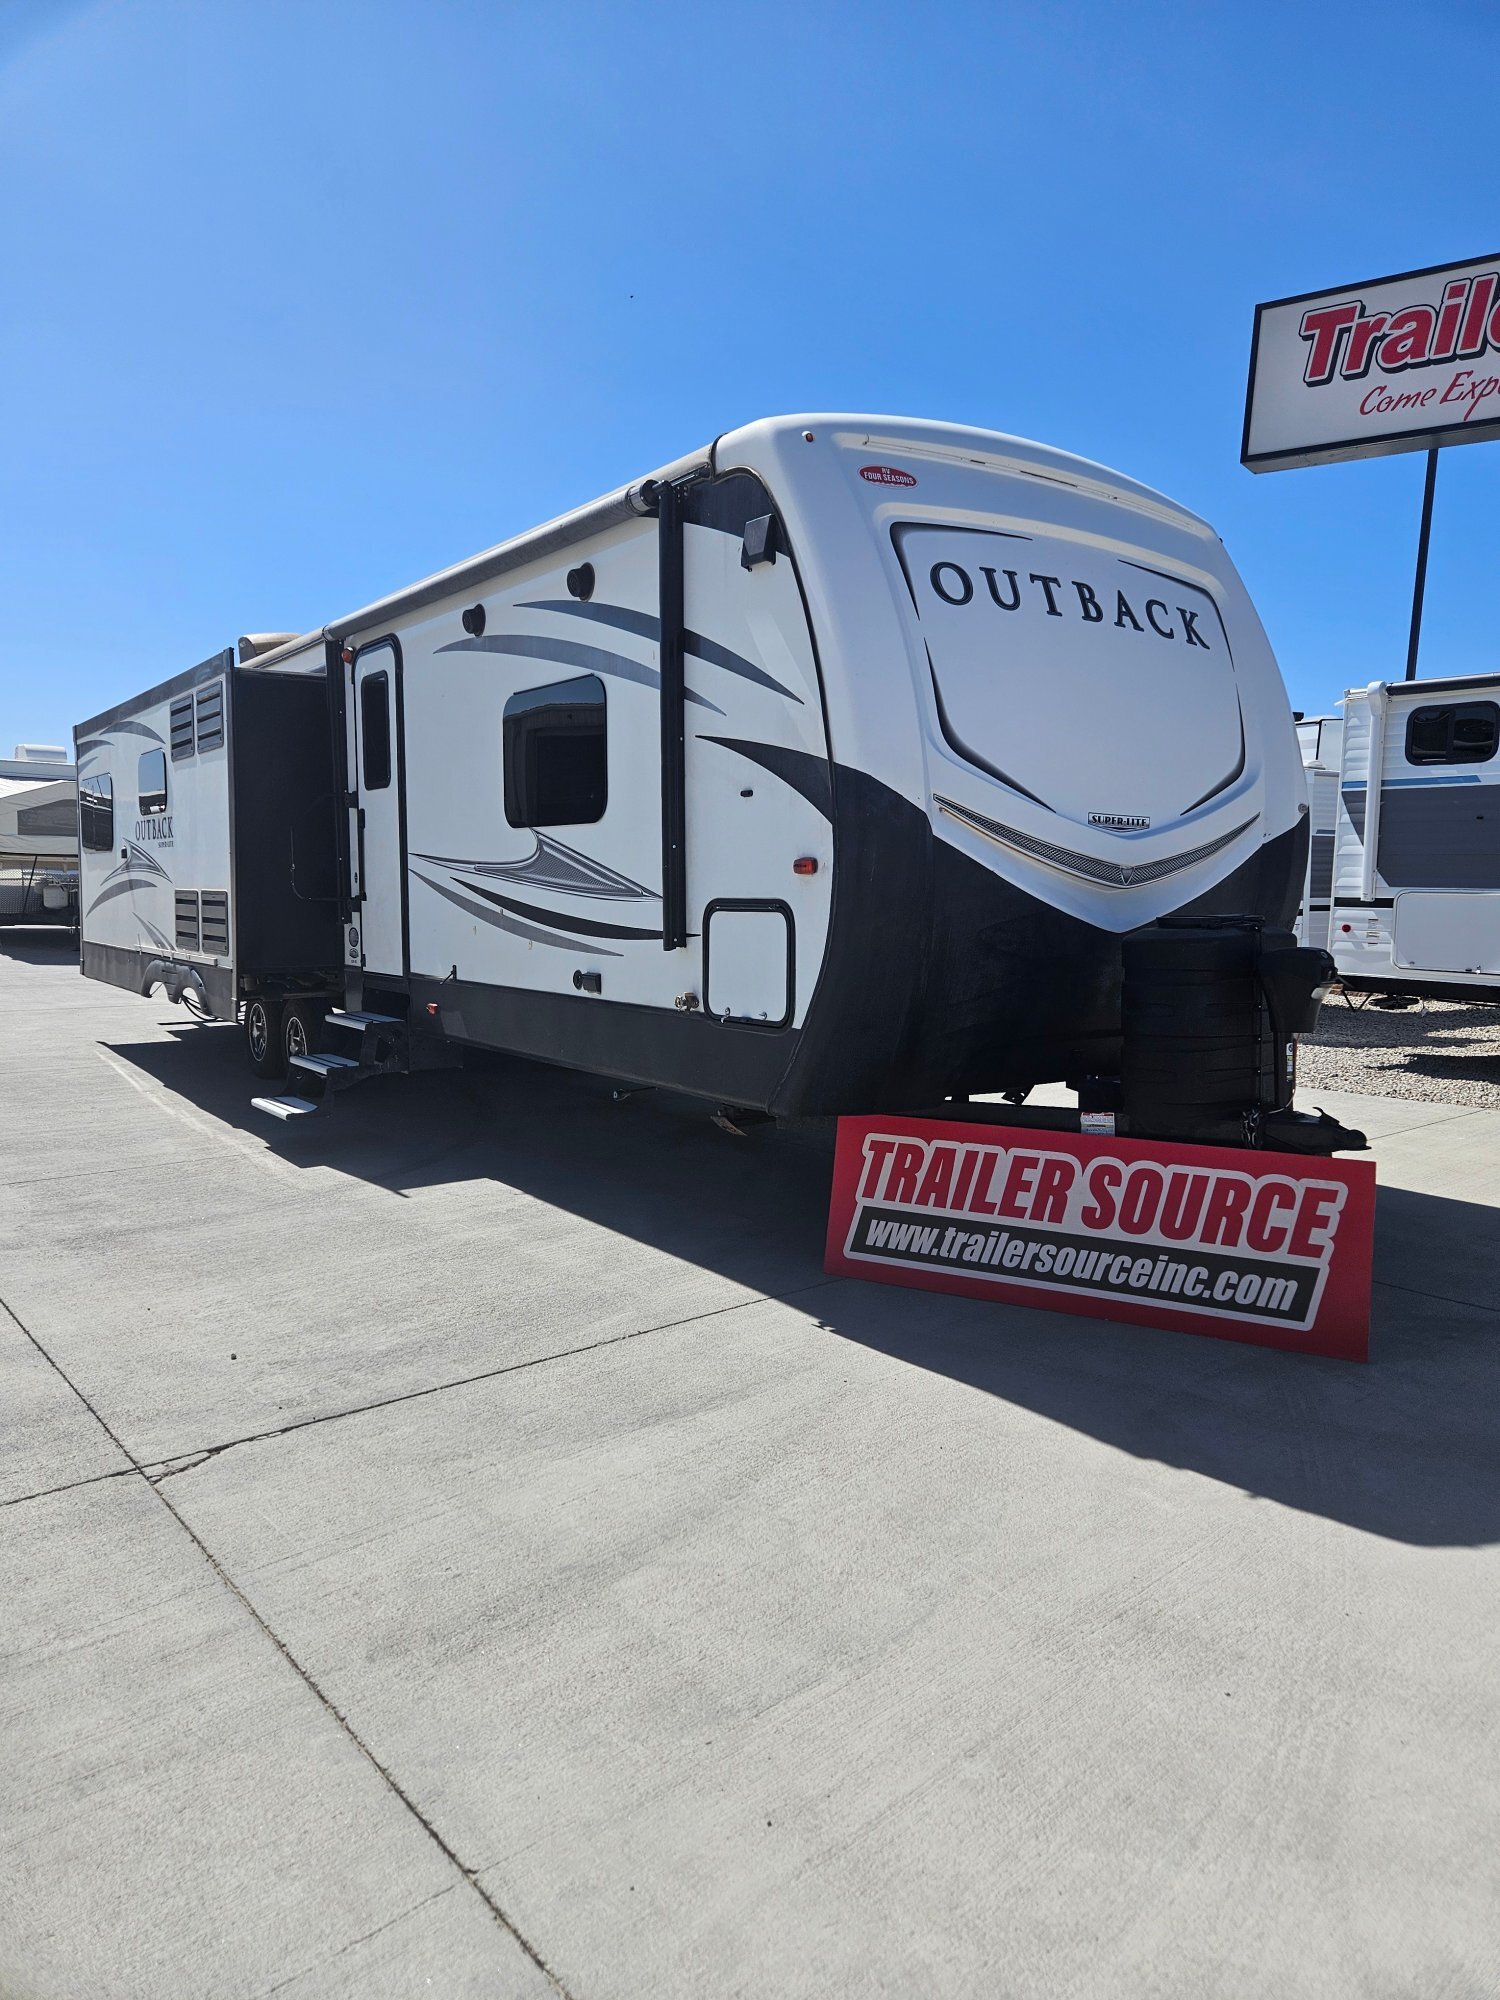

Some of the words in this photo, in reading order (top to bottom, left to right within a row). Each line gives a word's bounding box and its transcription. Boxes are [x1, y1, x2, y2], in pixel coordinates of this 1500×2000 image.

[1359, 385, 1437, 416] Come
[1439, 370, 1500, 422] Exp
[863, 471, 882, 481] FOUR
[882, 473, 914, 485] SEASONS
[929, 561, 1211, 650] OUTBACK
[135, 816, 174, 841] OUTBACK
[860, 1138, 1077, 1226] TRAILER
[1080, 1161, 1344, 1259] SOURCE
[864, 1217, 1300, 1313] www.trailersourceinc.com
